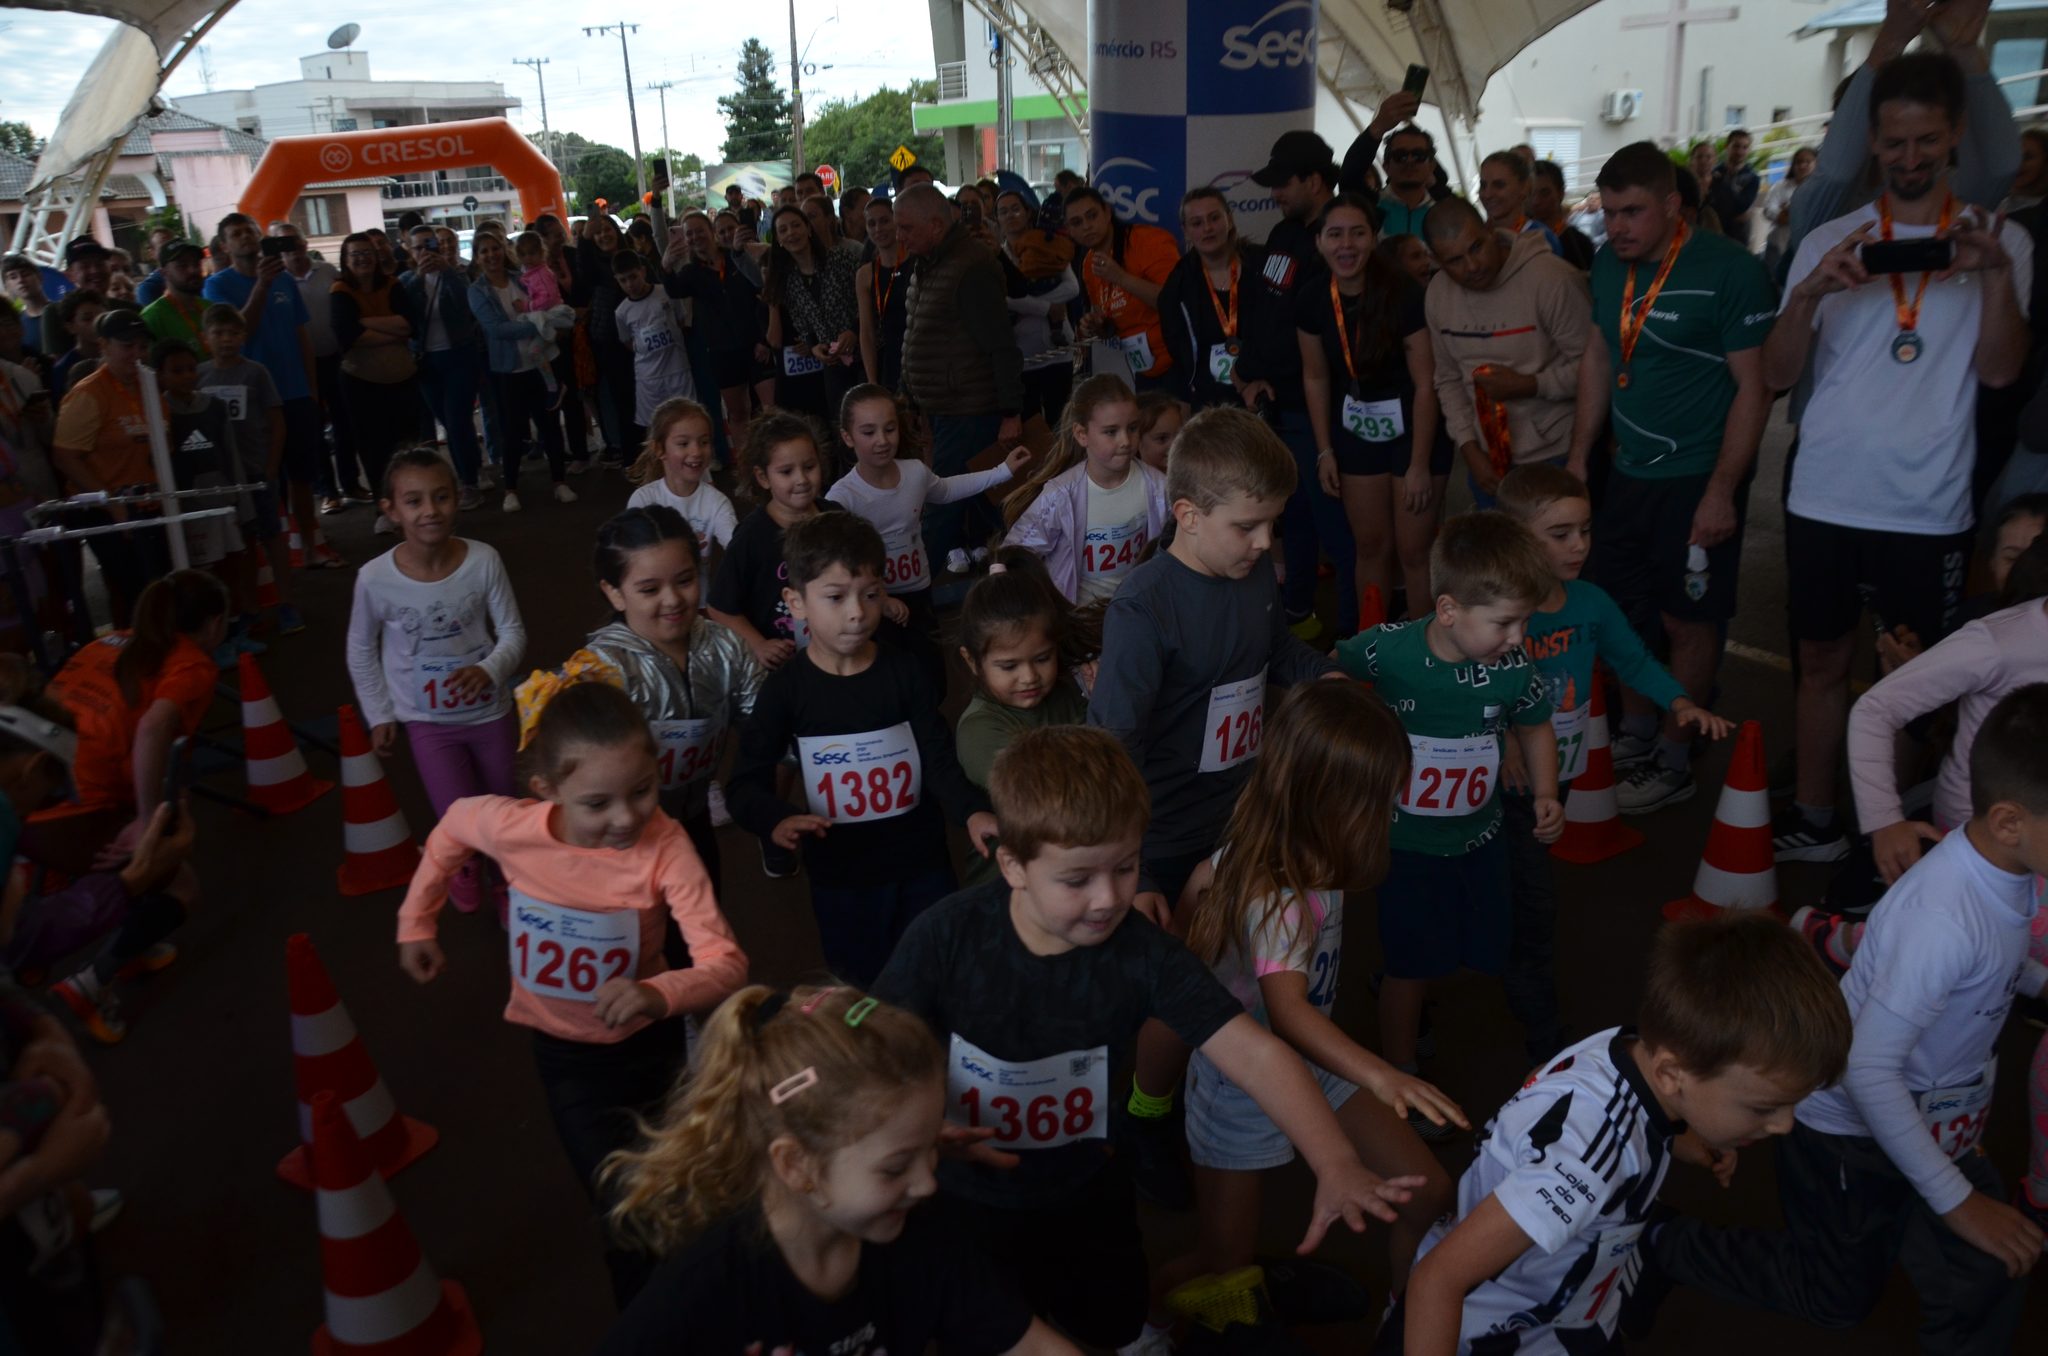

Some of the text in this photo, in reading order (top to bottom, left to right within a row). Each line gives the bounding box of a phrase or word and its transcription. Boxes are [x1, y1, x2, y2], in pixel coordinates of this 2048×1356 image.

[1150, 41, 1177, 60] RS
[361, 135, 474, 166] CRESOL
[1098, 182, 1159, 223] esc
[1349, 414, 1396, 438] 293
[882, 549, 921, 584] 366
[423, 678, 493, 709] 13
[1215, 704, 1265, 763] 126
[817, 760, 915, 819] 1382
[515, 932, 631, 993] 1262
[959, 1086, 1094, 1142] 1368
[1554, 1185, 1576, 1205] do
